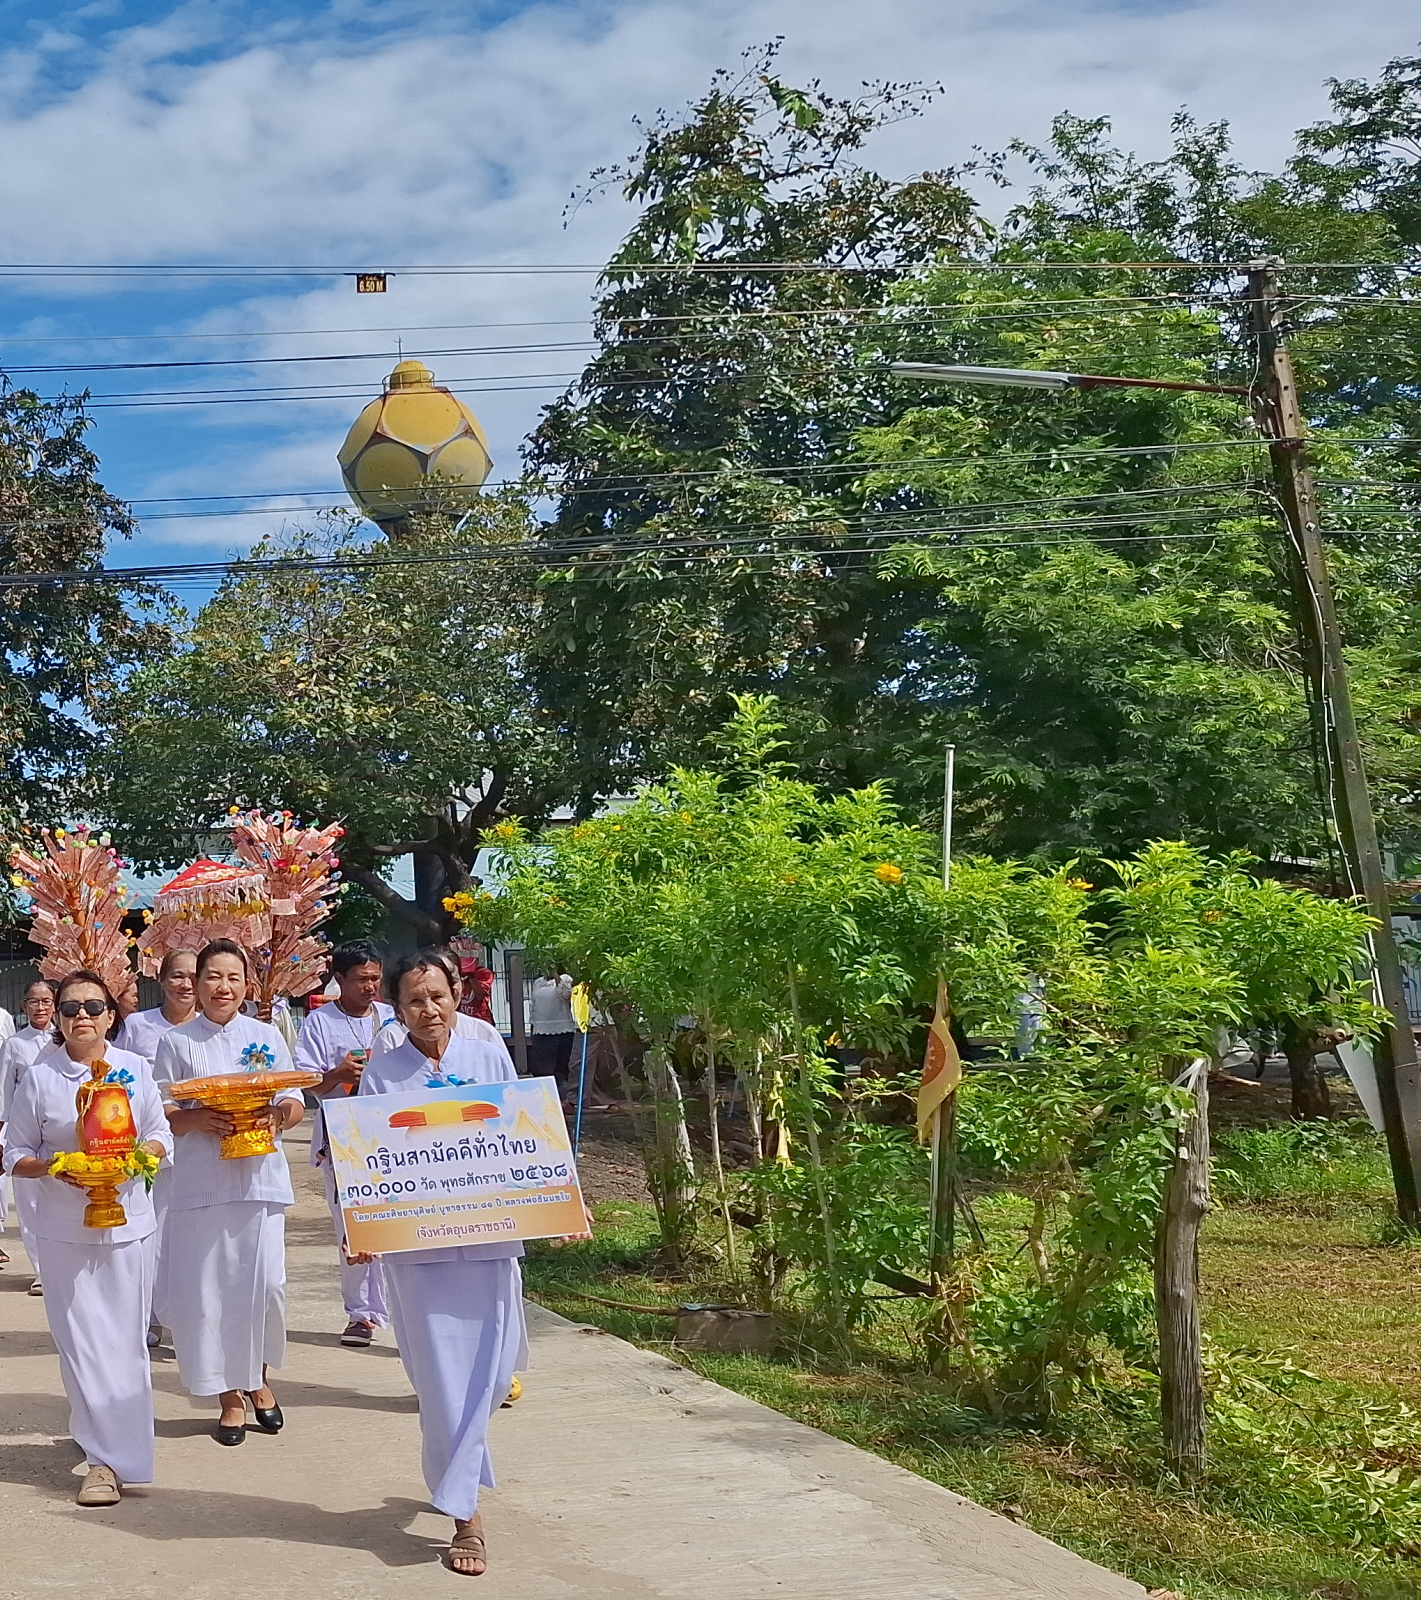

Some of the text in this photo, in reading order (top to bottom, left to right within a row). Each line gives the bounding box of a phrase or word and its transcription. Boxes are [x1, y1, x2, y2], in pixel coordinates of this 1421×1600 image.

[366, 1131, 537, 1175] กฐินสามัคคีทั่วไทย
[347, 1162, 568, 1199] ๓๐,๐๐๐ วัด พุทธศักราช ๒๕๖๘
[417, 1220, 516, 1240] (จังหวัดอุบลราชธานี)
